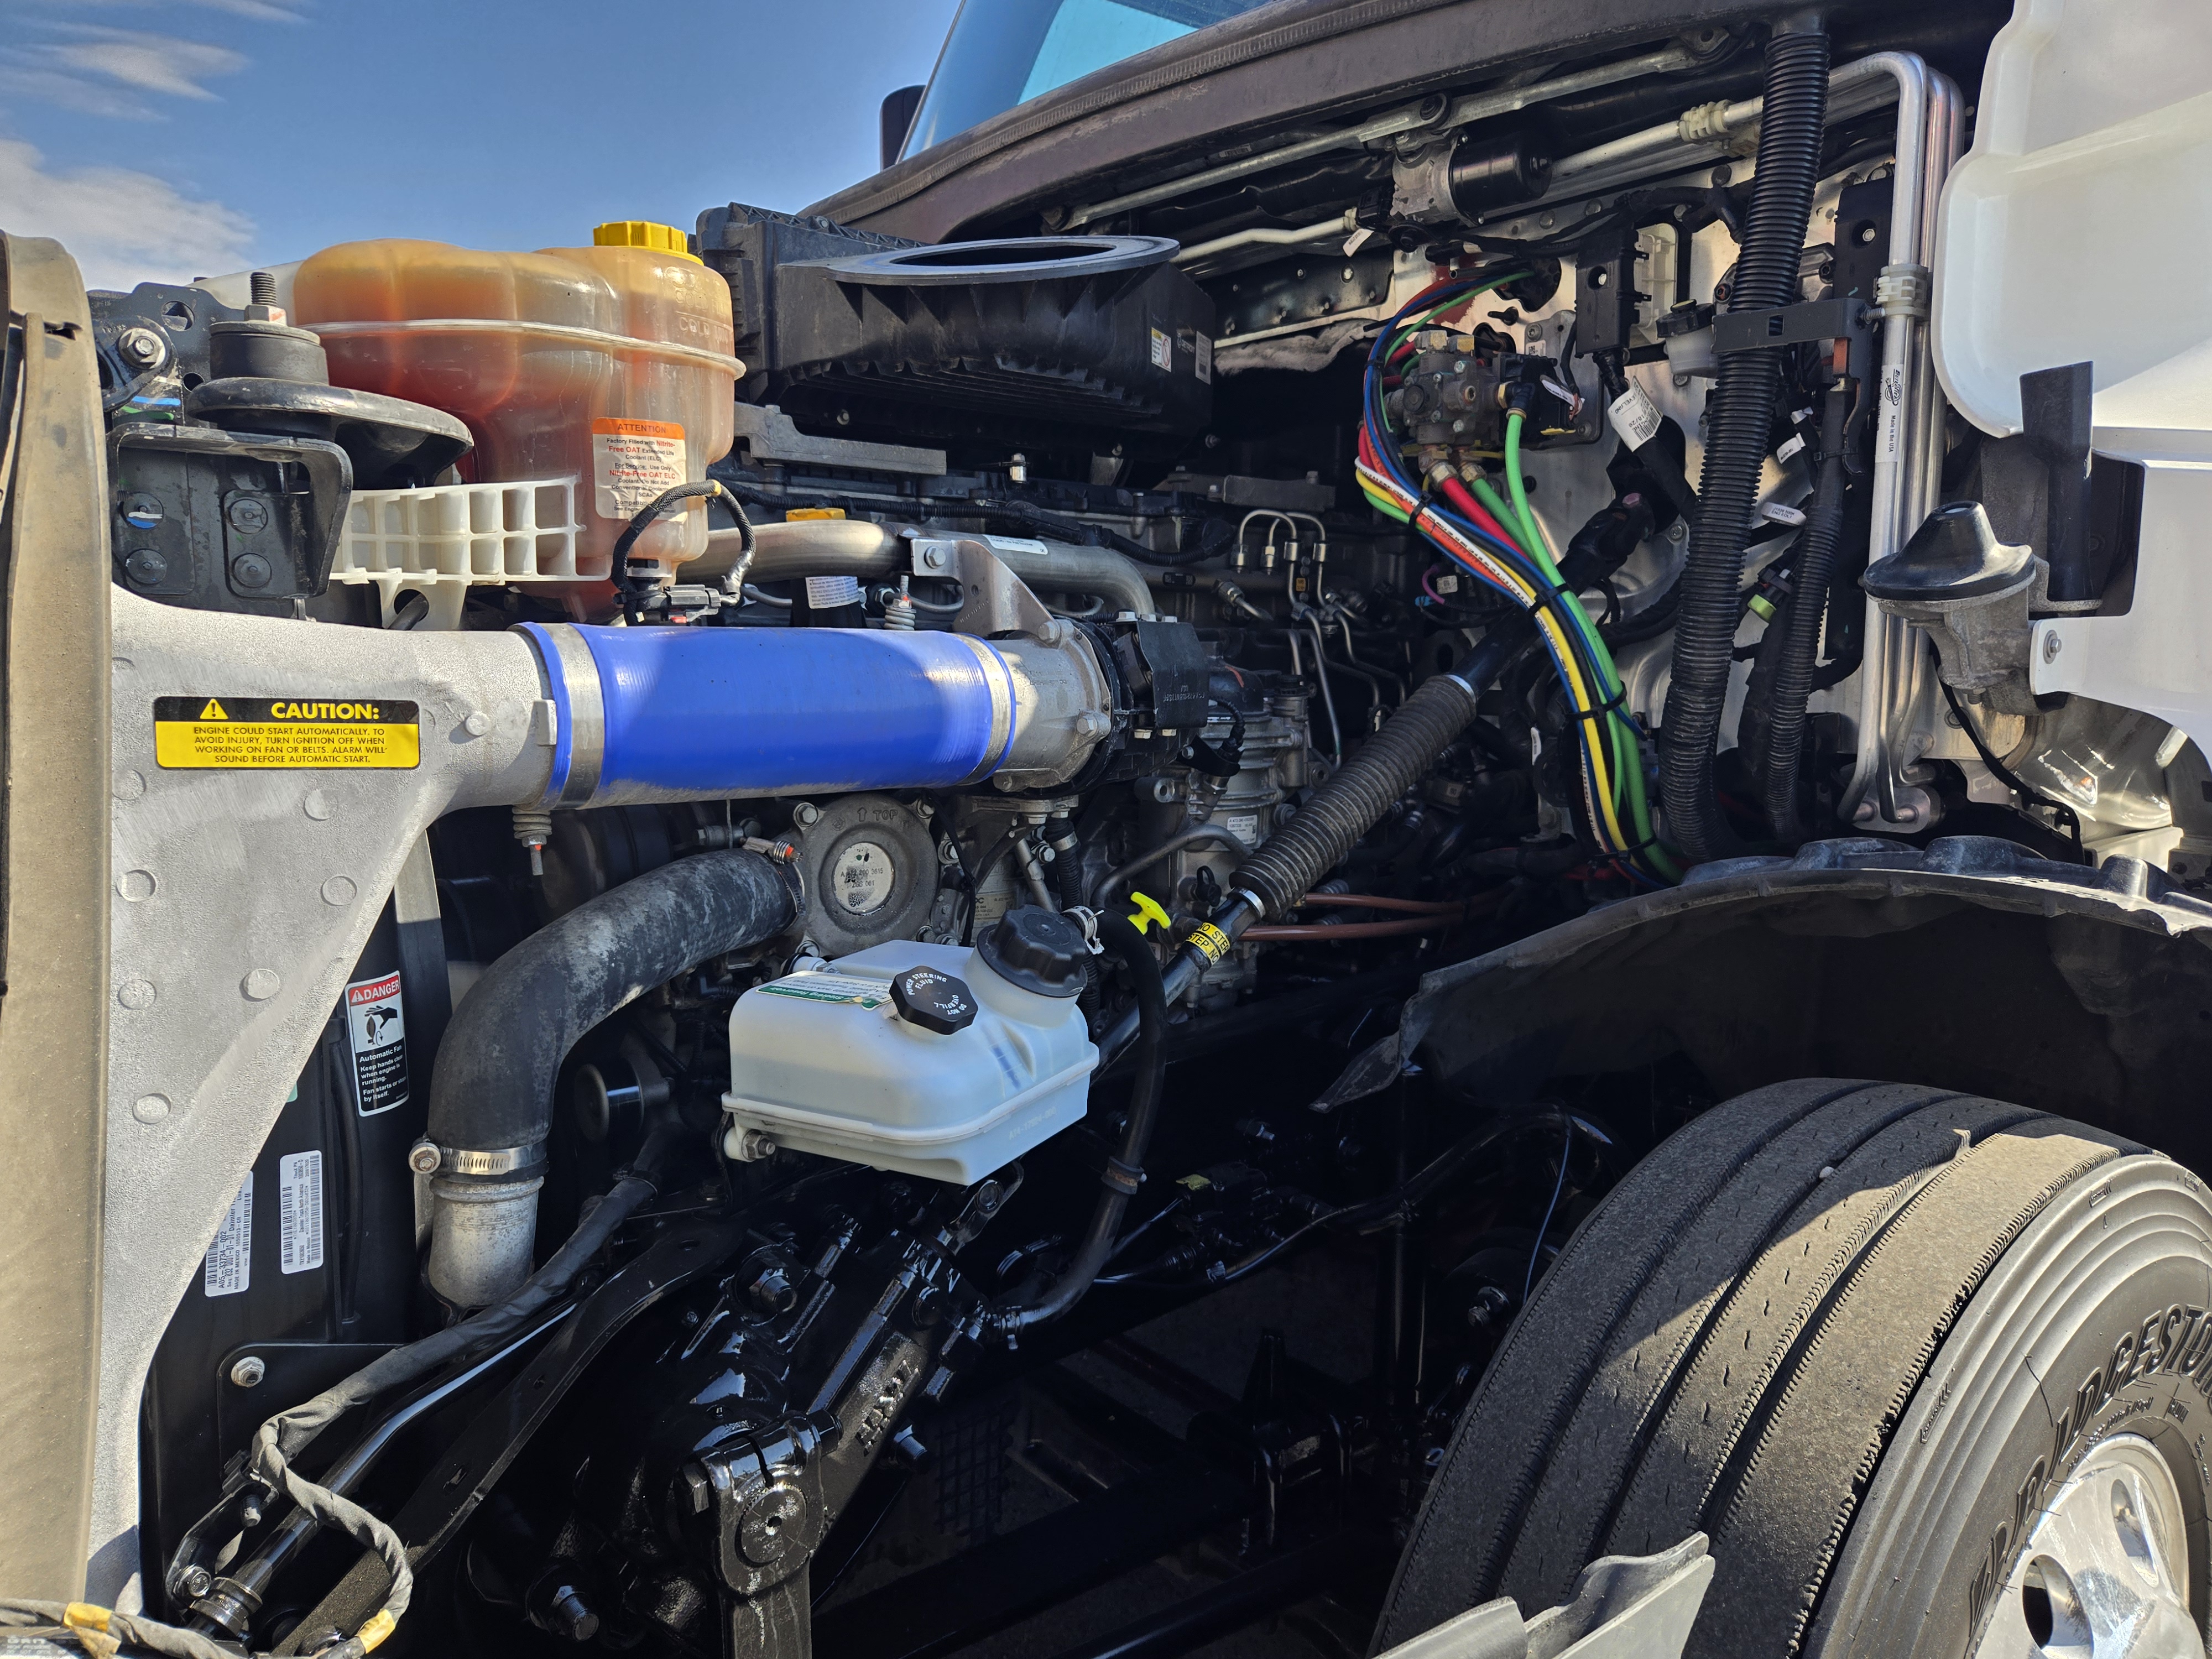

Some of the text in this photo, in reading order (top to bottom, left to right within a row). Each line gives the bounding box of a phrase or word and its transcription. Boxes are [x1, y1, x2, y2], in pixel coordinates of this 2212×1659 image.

[679, 317, 711, 338] COLD
[1614, 392, 1636, 414] LEVELAND
[617, 424, 666, 433] ATTENTION
[272, 702, 379, 719] CAUTION:
[228, 737, 262, 745] INJURY,
[873, 809, 898, 821] TOP
[1187, 933, 1219, 963] STEP NO
[1212, 931, 1229, 951] STEP
[363, 979, 399, 1000] DANGER
[906, 973, 947, 995] POWER STEERING
[915, 979, 933, 989] FLUID
[933, 994, 959, 1009] OVERFILL
[359, 1045, 402, 1063] Automatic Fan
[360, 1055, 403, 1073] Keep hands clear
[361, 1071, 378, 1079] when
[379, 1065, 395, 1076] engine
[362, 1076, 387, 1086] running.
[375, 1082, 392, 1093] starts
[373, 1091, 389, 1100] itself.
[218, 1230, 227, 1288] A05-33734-002
